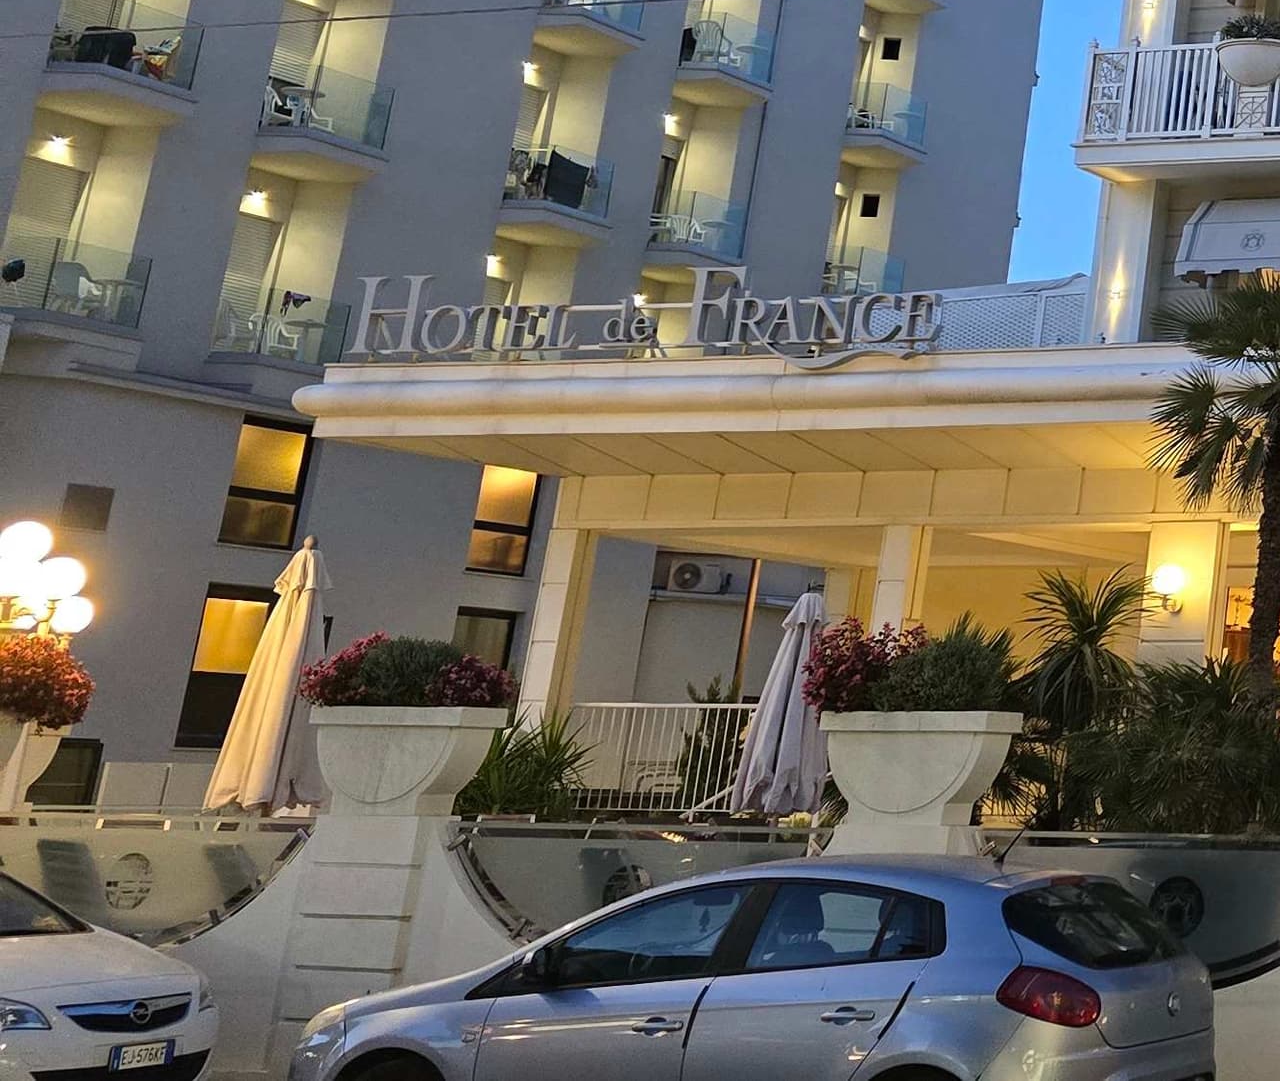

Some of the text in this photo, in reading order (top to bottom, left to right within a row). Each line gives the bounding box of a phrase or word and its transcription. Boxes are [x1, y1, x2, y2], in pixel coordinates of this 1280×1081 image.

[344, 266, 943, 369] HOTEL de FRANCE
